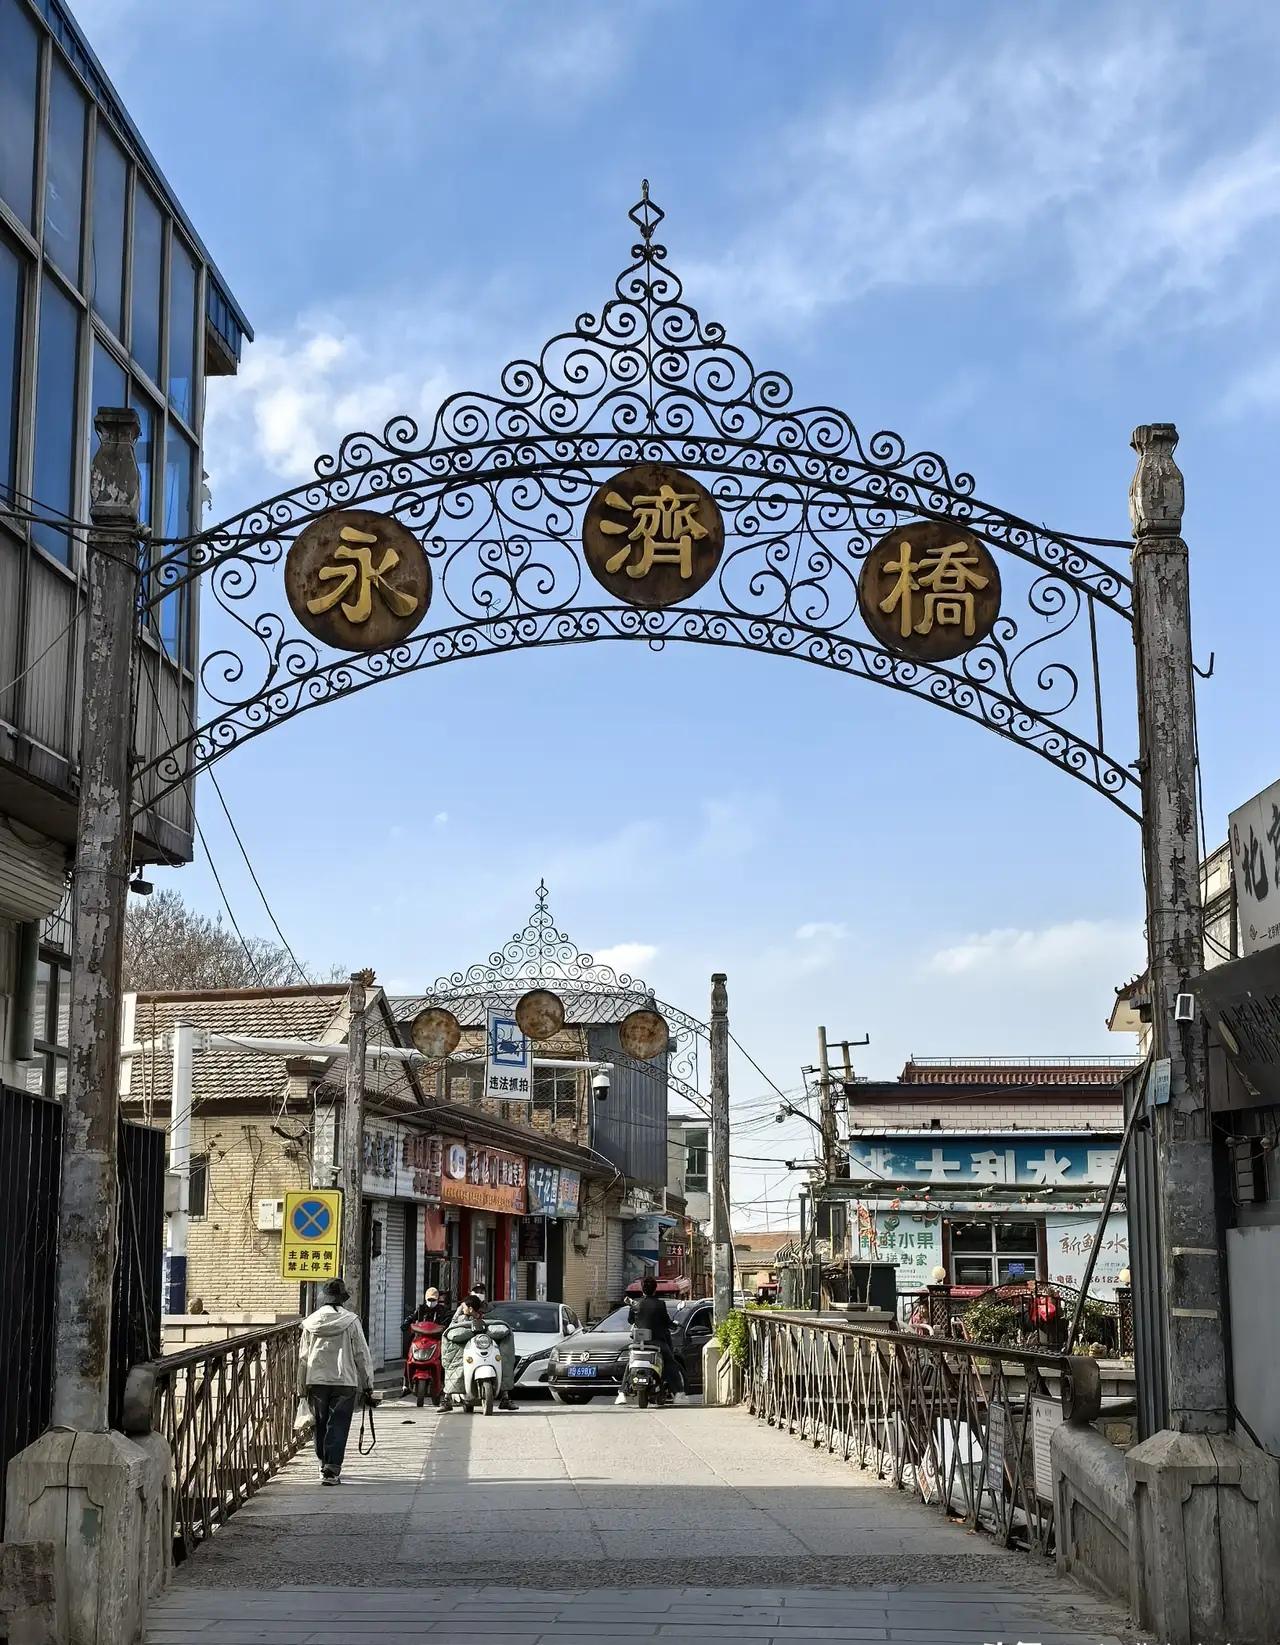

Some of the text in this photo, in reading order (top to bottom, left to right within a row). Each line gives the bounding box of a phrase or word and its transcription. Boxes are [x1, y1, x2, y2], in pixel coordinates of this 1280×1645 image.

[489, 1076, 529, 1092] 违法抓拍
[288, 1250, 333, 1260] 主路两侧
[288, 1262, 332, 1272] 禁止停车
